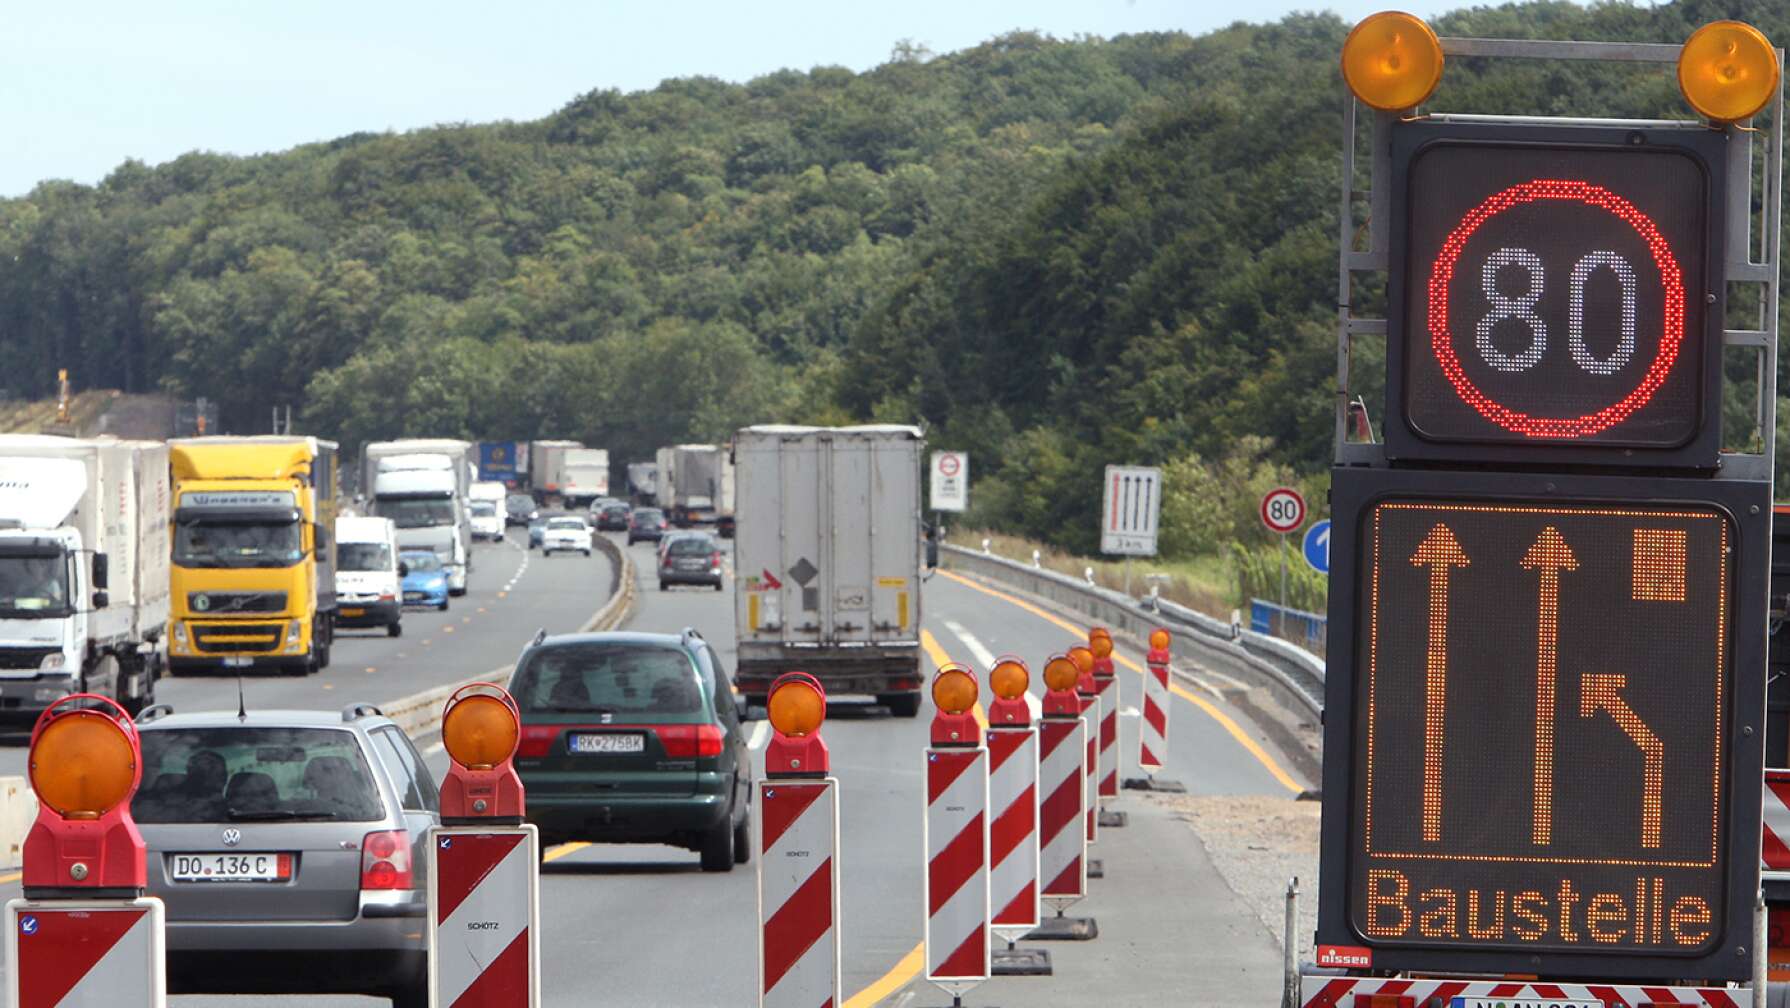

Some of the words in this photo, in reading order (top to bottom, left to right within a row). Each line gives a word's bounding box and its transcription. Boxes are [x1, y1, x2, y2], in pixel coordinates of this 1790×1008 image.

[1476, 247, 1637, 375] 80
[1271, 500, 1296, 520] 80
[178, 857, 202, 875] DO
[215, 857, 250, 875] 136
[256, 856, 267, 874] C
[1367, 869, 1712, 945] Baustelle
[1321, 949, 1369, 965] nissen
